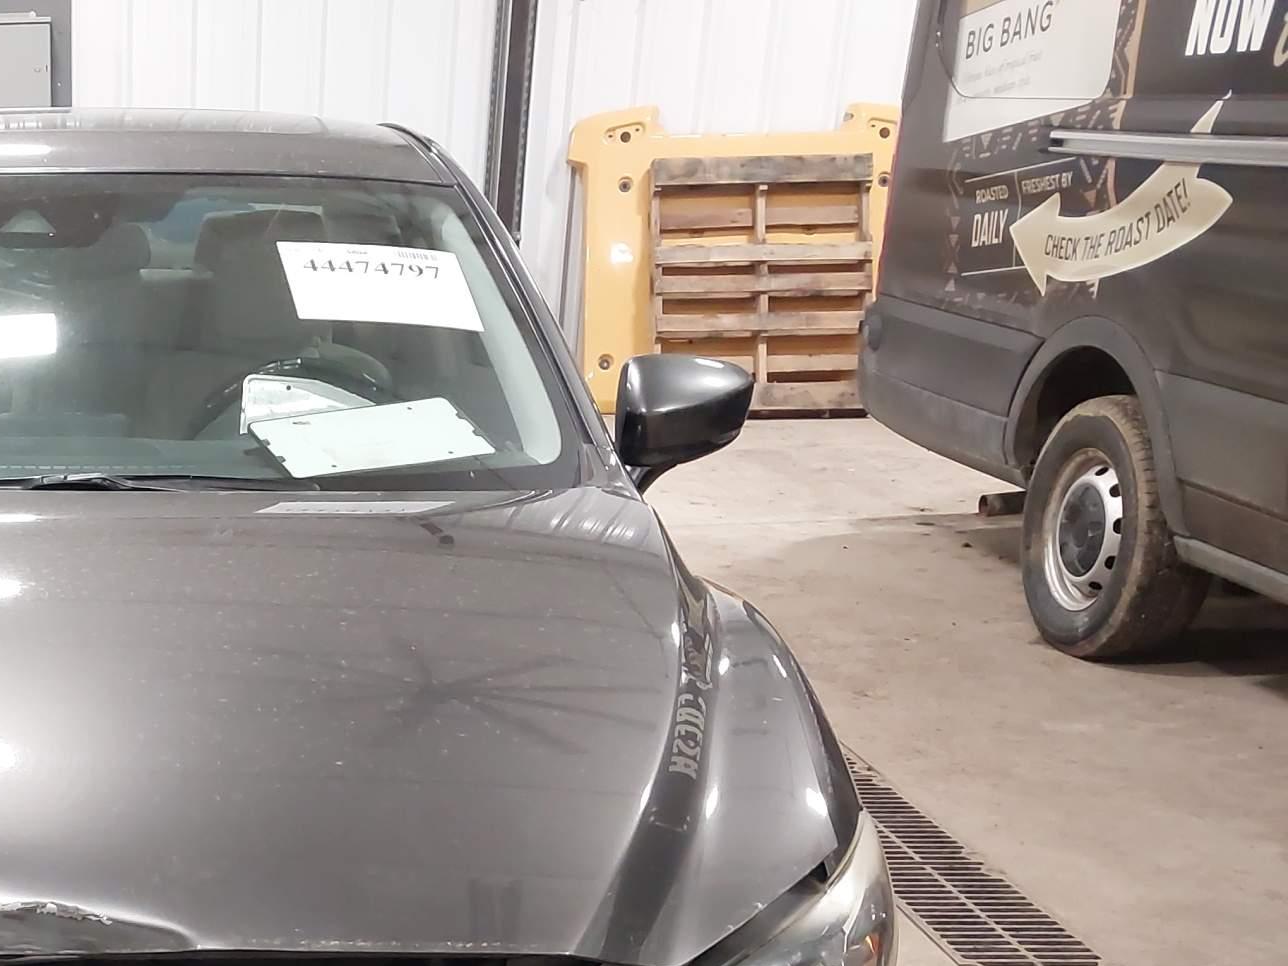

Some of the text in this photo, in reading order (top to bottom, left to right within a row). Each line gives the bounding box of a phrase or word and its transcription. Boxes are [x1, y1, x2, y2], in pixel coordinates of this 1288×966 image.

[965, 0, 1054, 60] BIG BANG
[975, 184, 1009, 204] ROASTED
[1021, 171, 1073, 195] FRESHEST BY
[971, 208, 1009, 248] DAILY
[1044, 177, 1191, 261] CHECK THE ROAST DATE!
[302, 258, 440, 279] 44474797
